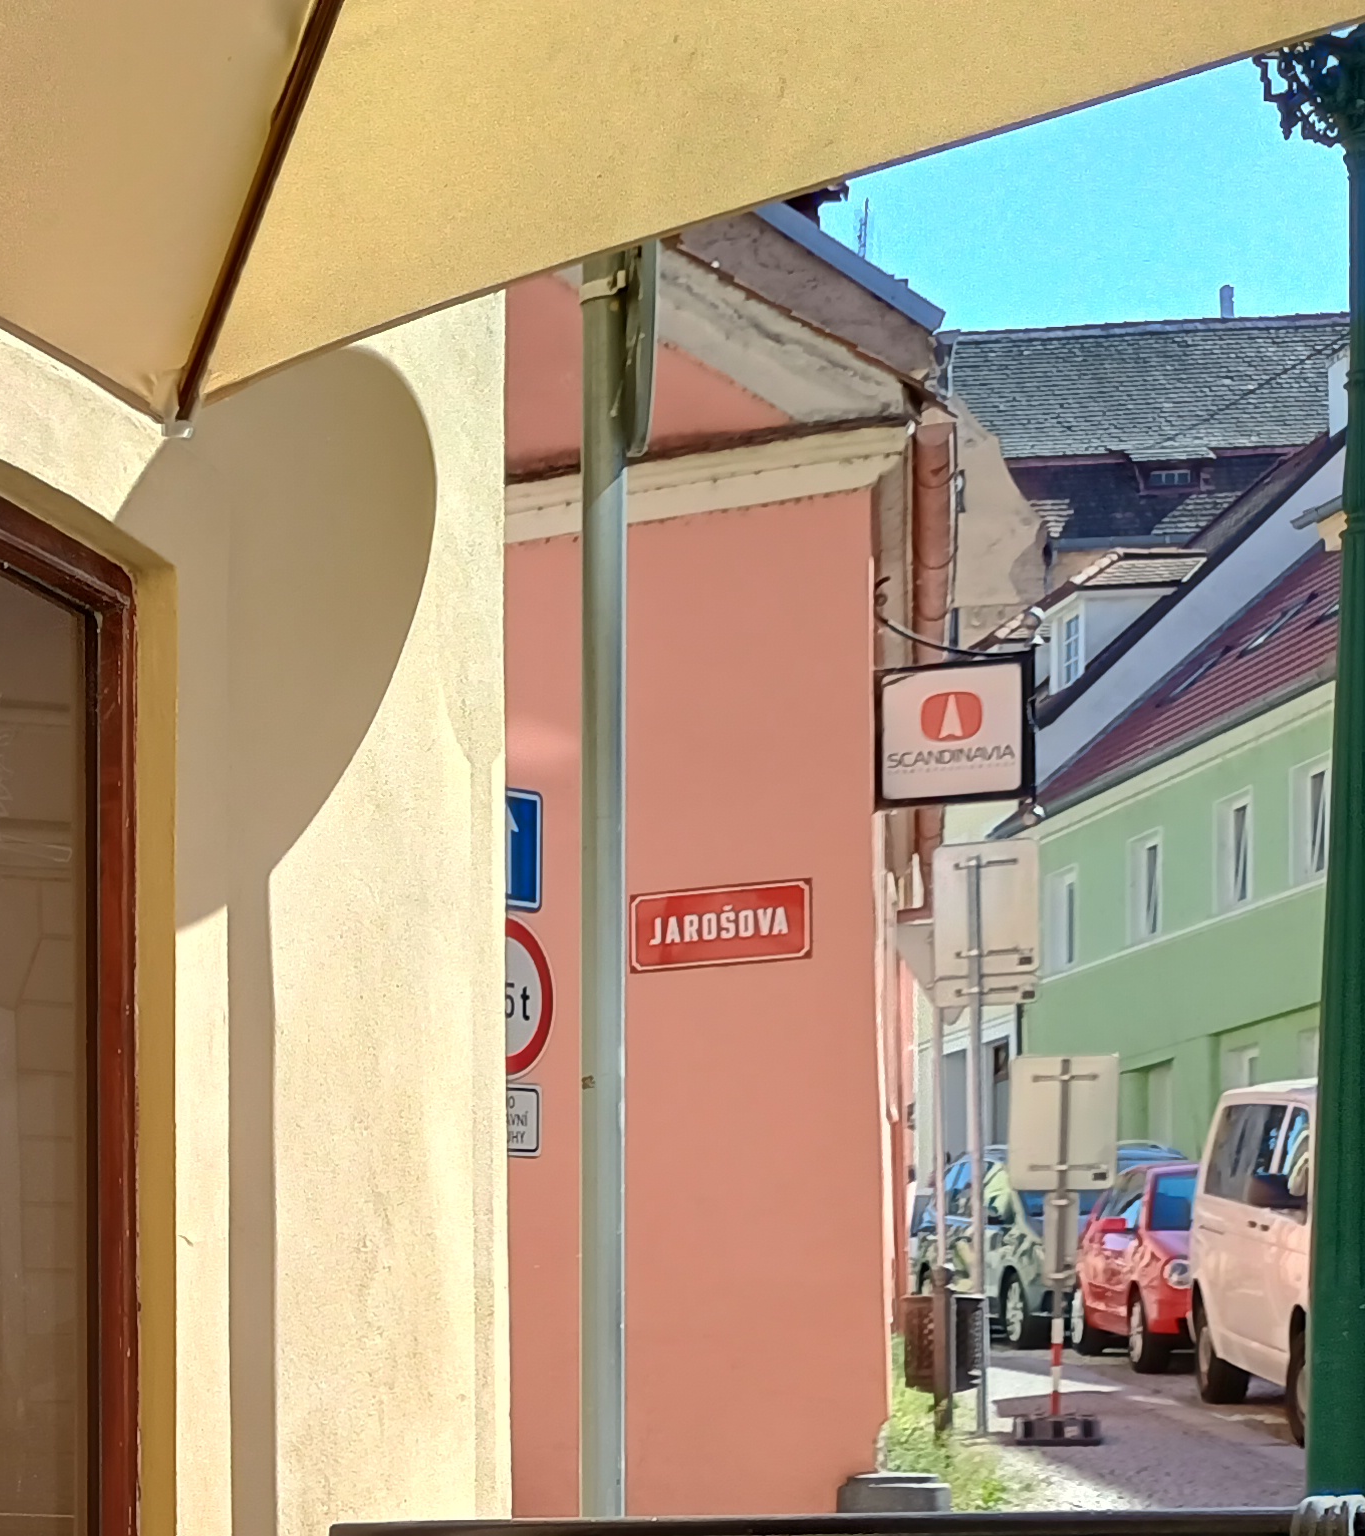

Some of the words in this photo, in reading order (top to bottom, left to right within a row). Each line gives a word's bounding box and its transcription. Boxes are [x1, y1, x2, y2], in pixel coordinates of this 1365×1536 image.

[886, 744, 1016, 769] SCANDINAVIA
[648, 904, 789, 946] JAROŠOVA
[520, 986, 530, 1021] t
